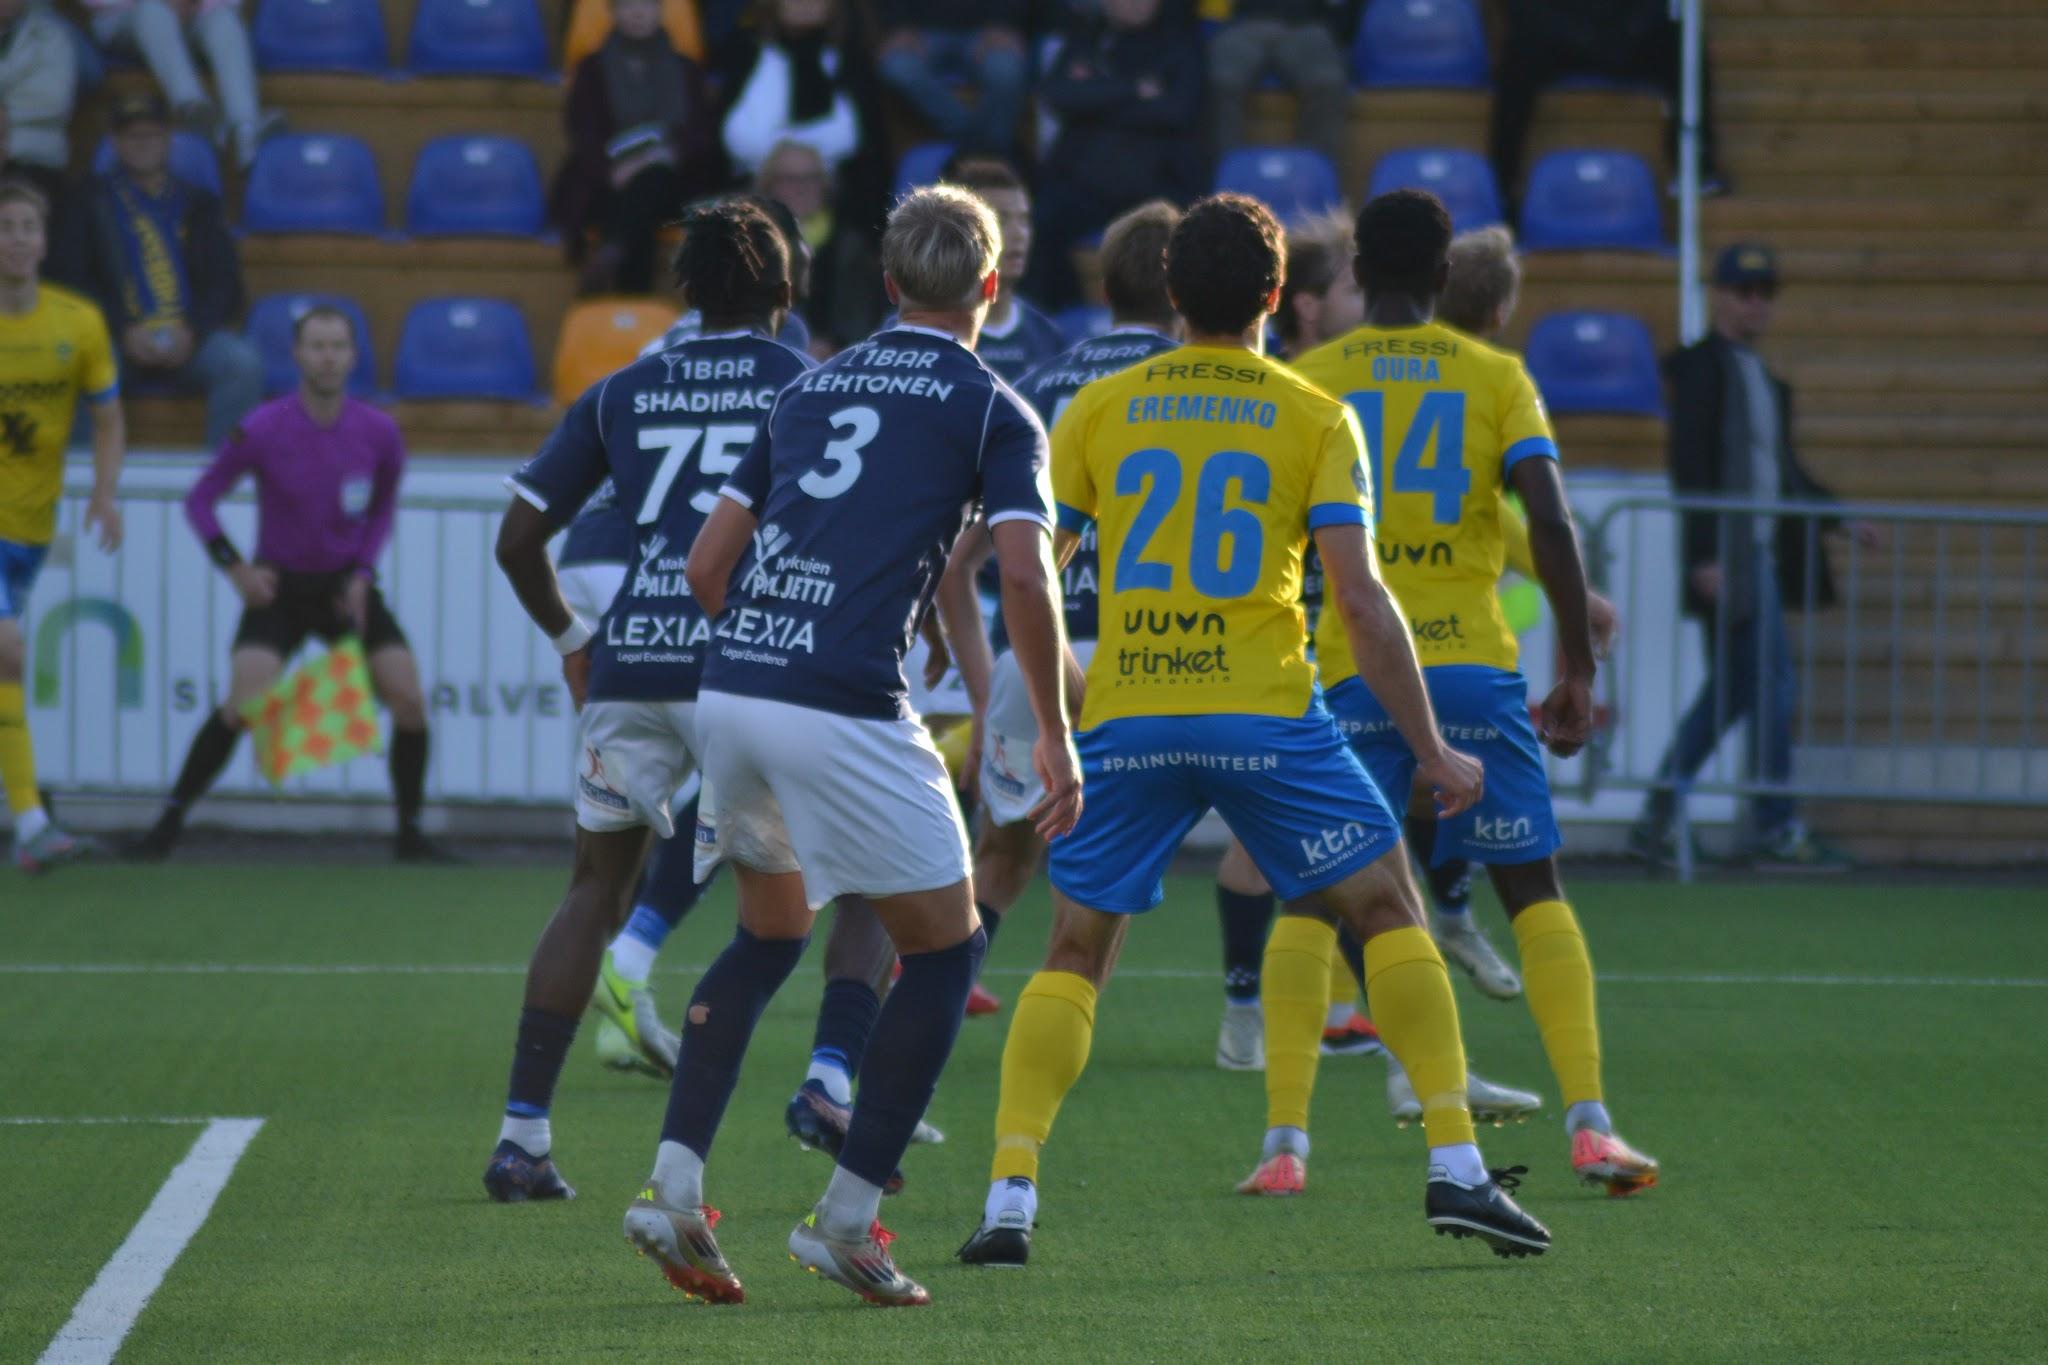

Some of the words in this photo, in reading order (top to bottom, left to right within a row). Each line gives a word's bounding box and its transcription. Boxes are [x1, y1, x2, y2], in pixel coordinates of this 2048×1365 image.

[863, 348, 940, 369] 1BAR
[1343, 338, 1459, 360] FRESSI
[682, 358, 756, 381] 1BAR
[1145, 363, 1267, 385] FRESSI
[1371, 356, 1441, 382] OURA
[801, 374, 954, 402] LEHTONEN
[633, 389, 776, 414] SHADIRAC
[1126, 394, 1277, 430] EREMENKO
[797, 404, 880, 499] 3
[1341, 389, 1471, 525] 14
[636, 425, 757, 525] 75
[1114, 447, 1271, 599] 26
[632, 572, 692, 598] PALJE
[606, 613, 711, 647] LEXIA
[716, 607, 814, 654] LEXIA
[617, 651, 643, 664] Legal
[644, 651, 695, 664] Excellence
[1118, 644, 1229, 676] trinket
[1115, 675, 1231, 688] painotalo
[1102, 752, 1278, 773] #PAINUHIITEEN
[1475, 815, 1529, 841] ktn
[1300, 822, 1364, 866] ktn
